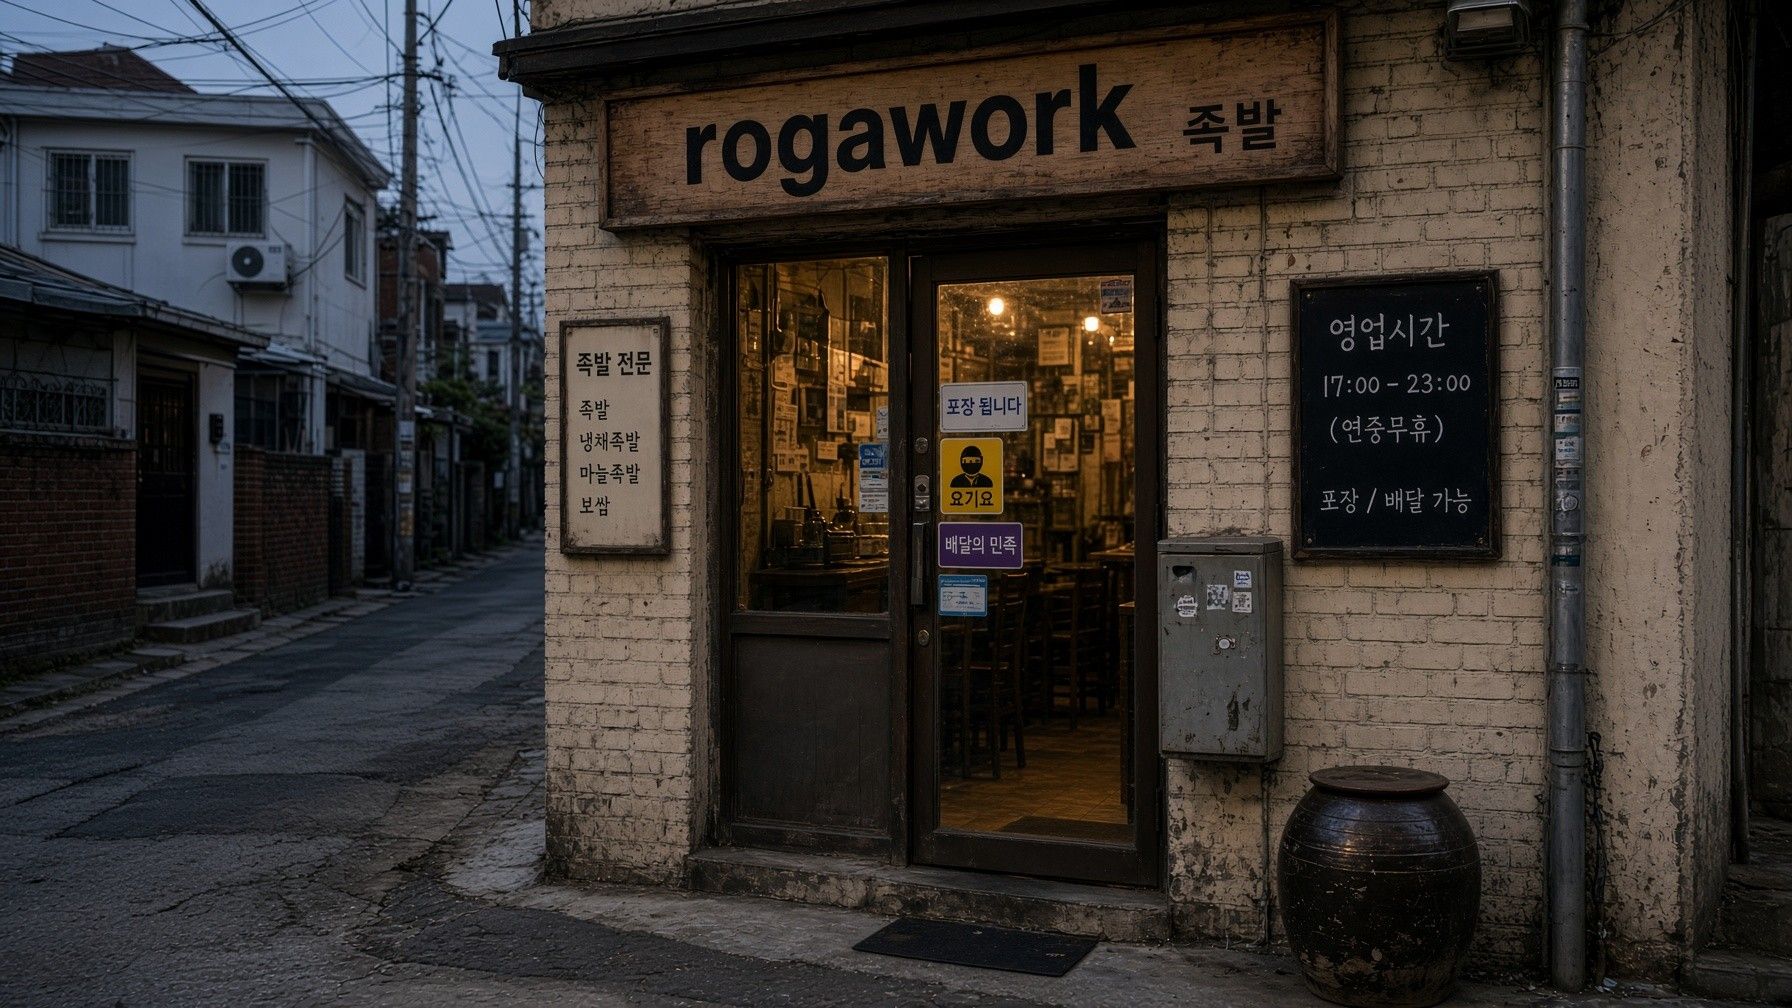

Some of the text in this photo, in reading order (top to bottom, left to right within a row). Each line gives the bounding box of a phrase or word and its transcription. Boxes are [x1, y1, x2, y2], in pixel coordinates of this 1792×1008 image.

[685, 64, 1137, 198] rogawork
[1183, 98, 1282, 154] 족발
[1330, 312, 1450, 351] 영업시간
[576, 351, 652, 376] 족발 전문
[1323, 375, 1380, 398] 17:00
[1407, 373, 1471, 394] 23:00
[578, 399, 610, 420] 족발
[946, 397, 975, 417] 포장
[1330, 414, 1443, 444] (연중무휴)
[579, 430, 641, 453] 냉채족발
[579, 463, 641, 485] 마늘족발
[579, 496, 611, 517] 보쌈
[949, 490, 994, 508] 요기요
[1320, 488, 1359, 514] 포장
[1385, 488, 1425, 514] 배달
[1433, 488, 1472, 514] 가능
[945, 535, 1017, 556] 배달의 민족
